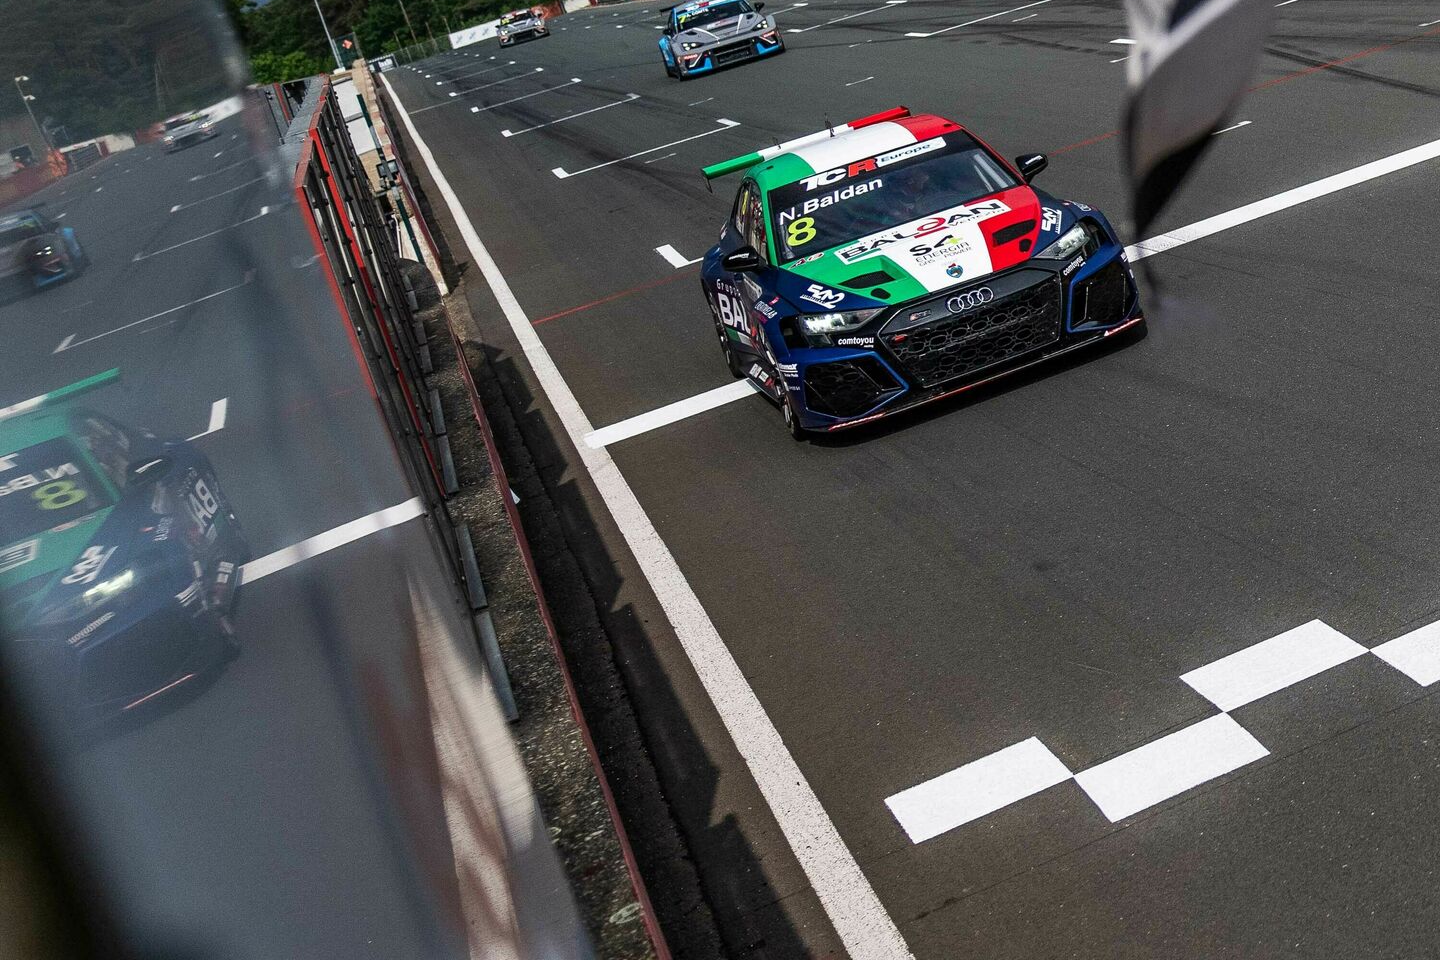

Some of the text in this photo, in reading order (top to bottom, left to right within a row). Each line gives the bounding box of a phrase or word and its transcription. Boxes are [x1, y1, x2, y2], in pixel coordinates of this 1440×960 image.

[880, 143, 932, 163] Europe
[787, 217, 817, 247] 8
[837, 335, 875, 346] comtoyou
